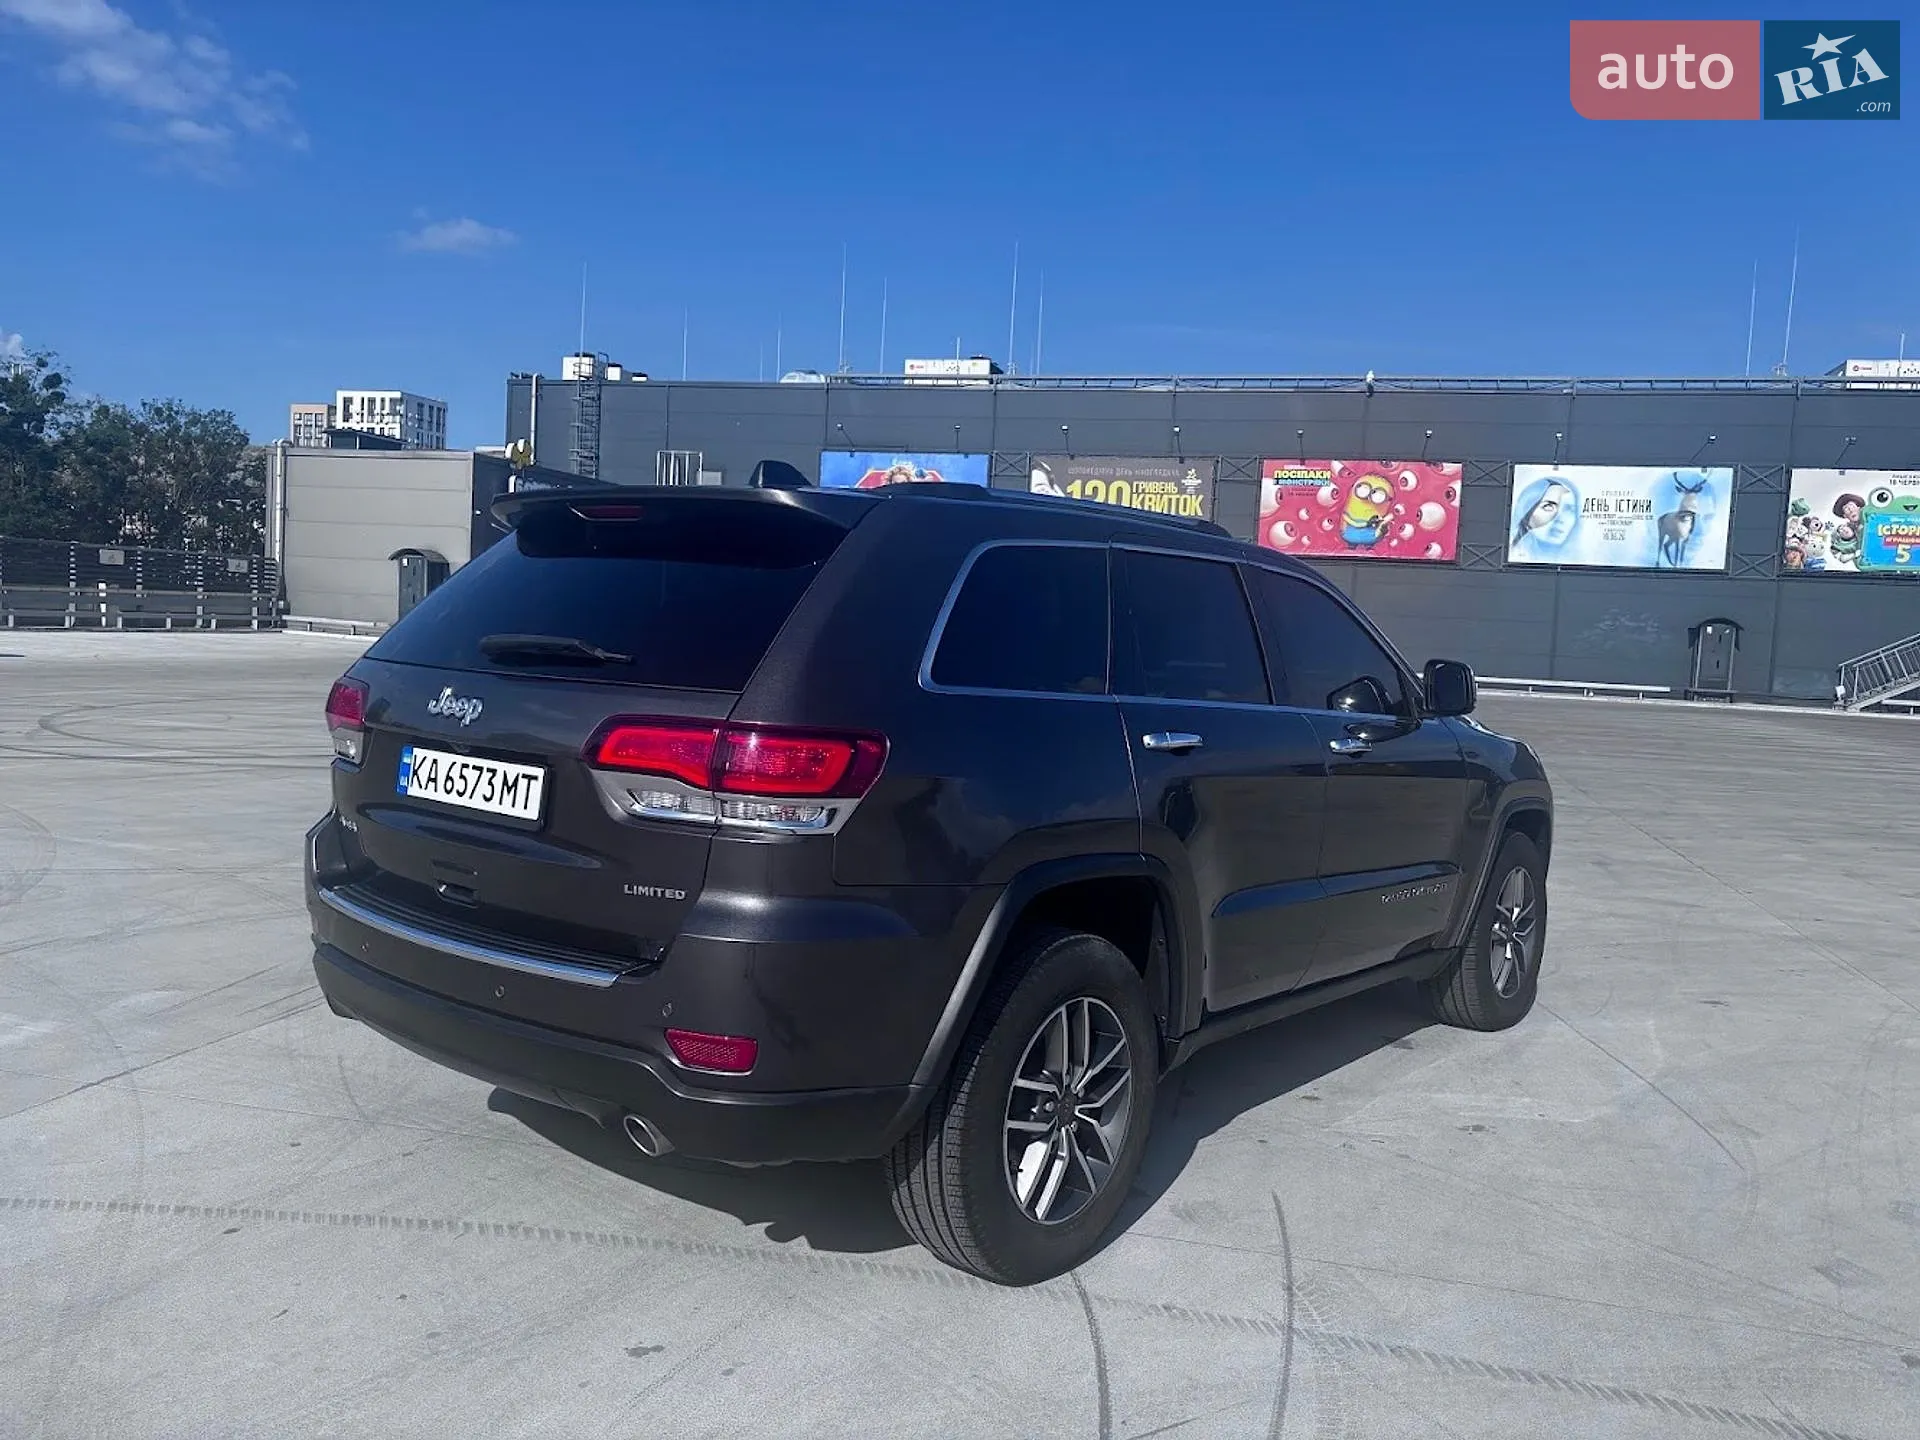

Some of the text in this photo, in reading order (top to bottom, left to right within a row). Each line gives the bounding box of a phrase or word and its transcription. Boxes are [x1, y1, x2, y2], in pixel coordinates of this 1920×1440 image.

[1273, 469, 1331, 479] ПОСІПАКИ
[1132, 481, 1179, 494] ГРИВЕНЬ
[1131, 493, 1204, 517] КВИТОК
[1582, 497, 1652, 514] ДЕНЬ ІСТИНИ
[1895, 544, 1911, 563] 5
[427, 686, 483, 727] Jeep
[623, 884, 686, 900] LIMITED
